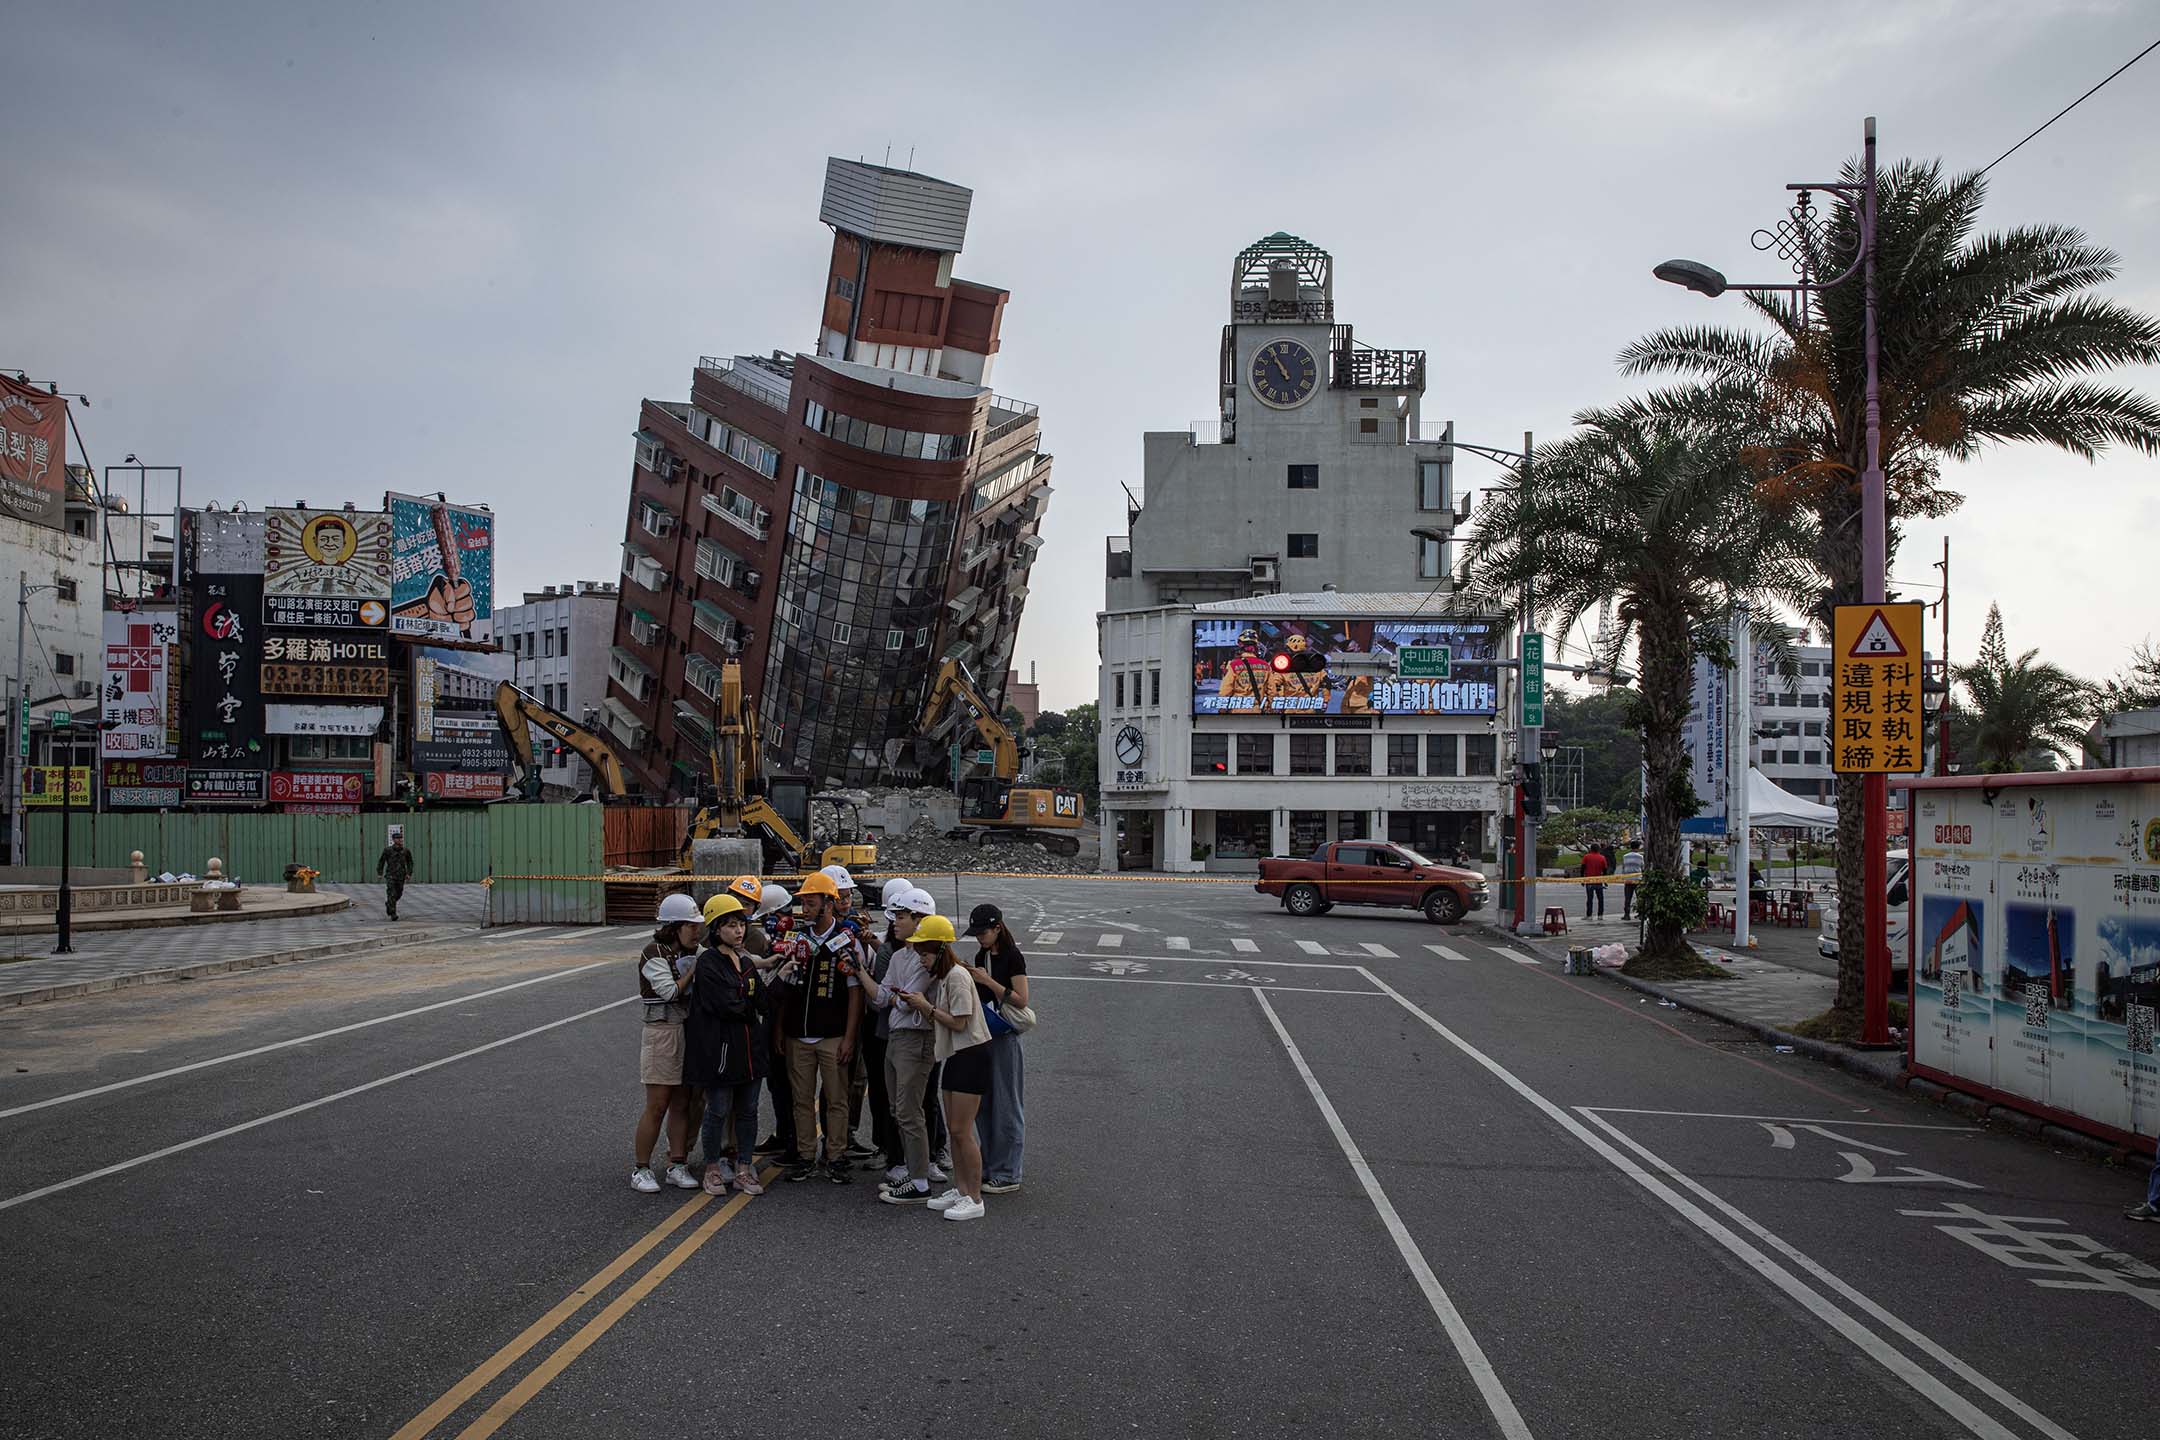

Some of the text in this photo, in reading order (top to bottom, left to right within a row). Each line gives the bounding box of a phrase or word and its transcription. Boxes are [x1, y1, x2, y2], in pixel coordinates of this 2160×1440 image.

[268, 598, 359, 612] 中山路北濱街交叉路口
[263, 637, 387, 662] 多羅滿 HOTEL
[1405, 649, 1444, 663] 中山路
[264, 665, 386, 683] 03-8316622
[1526, 647, 1540, 694] 花崗街
[1271, 696, 1325, 710] 花蓮加油
[1373, 682, 1489, 710] 謝謝你們
[968, 704, 980, 718] CAT
[1841, 662, 1874, 769] 違規取締
[1881, 662, 1915, 769] 科技執法
[203, 779, 257, 791] 有機山苦瓜
[1056, 794, 1077, 815] CAT
